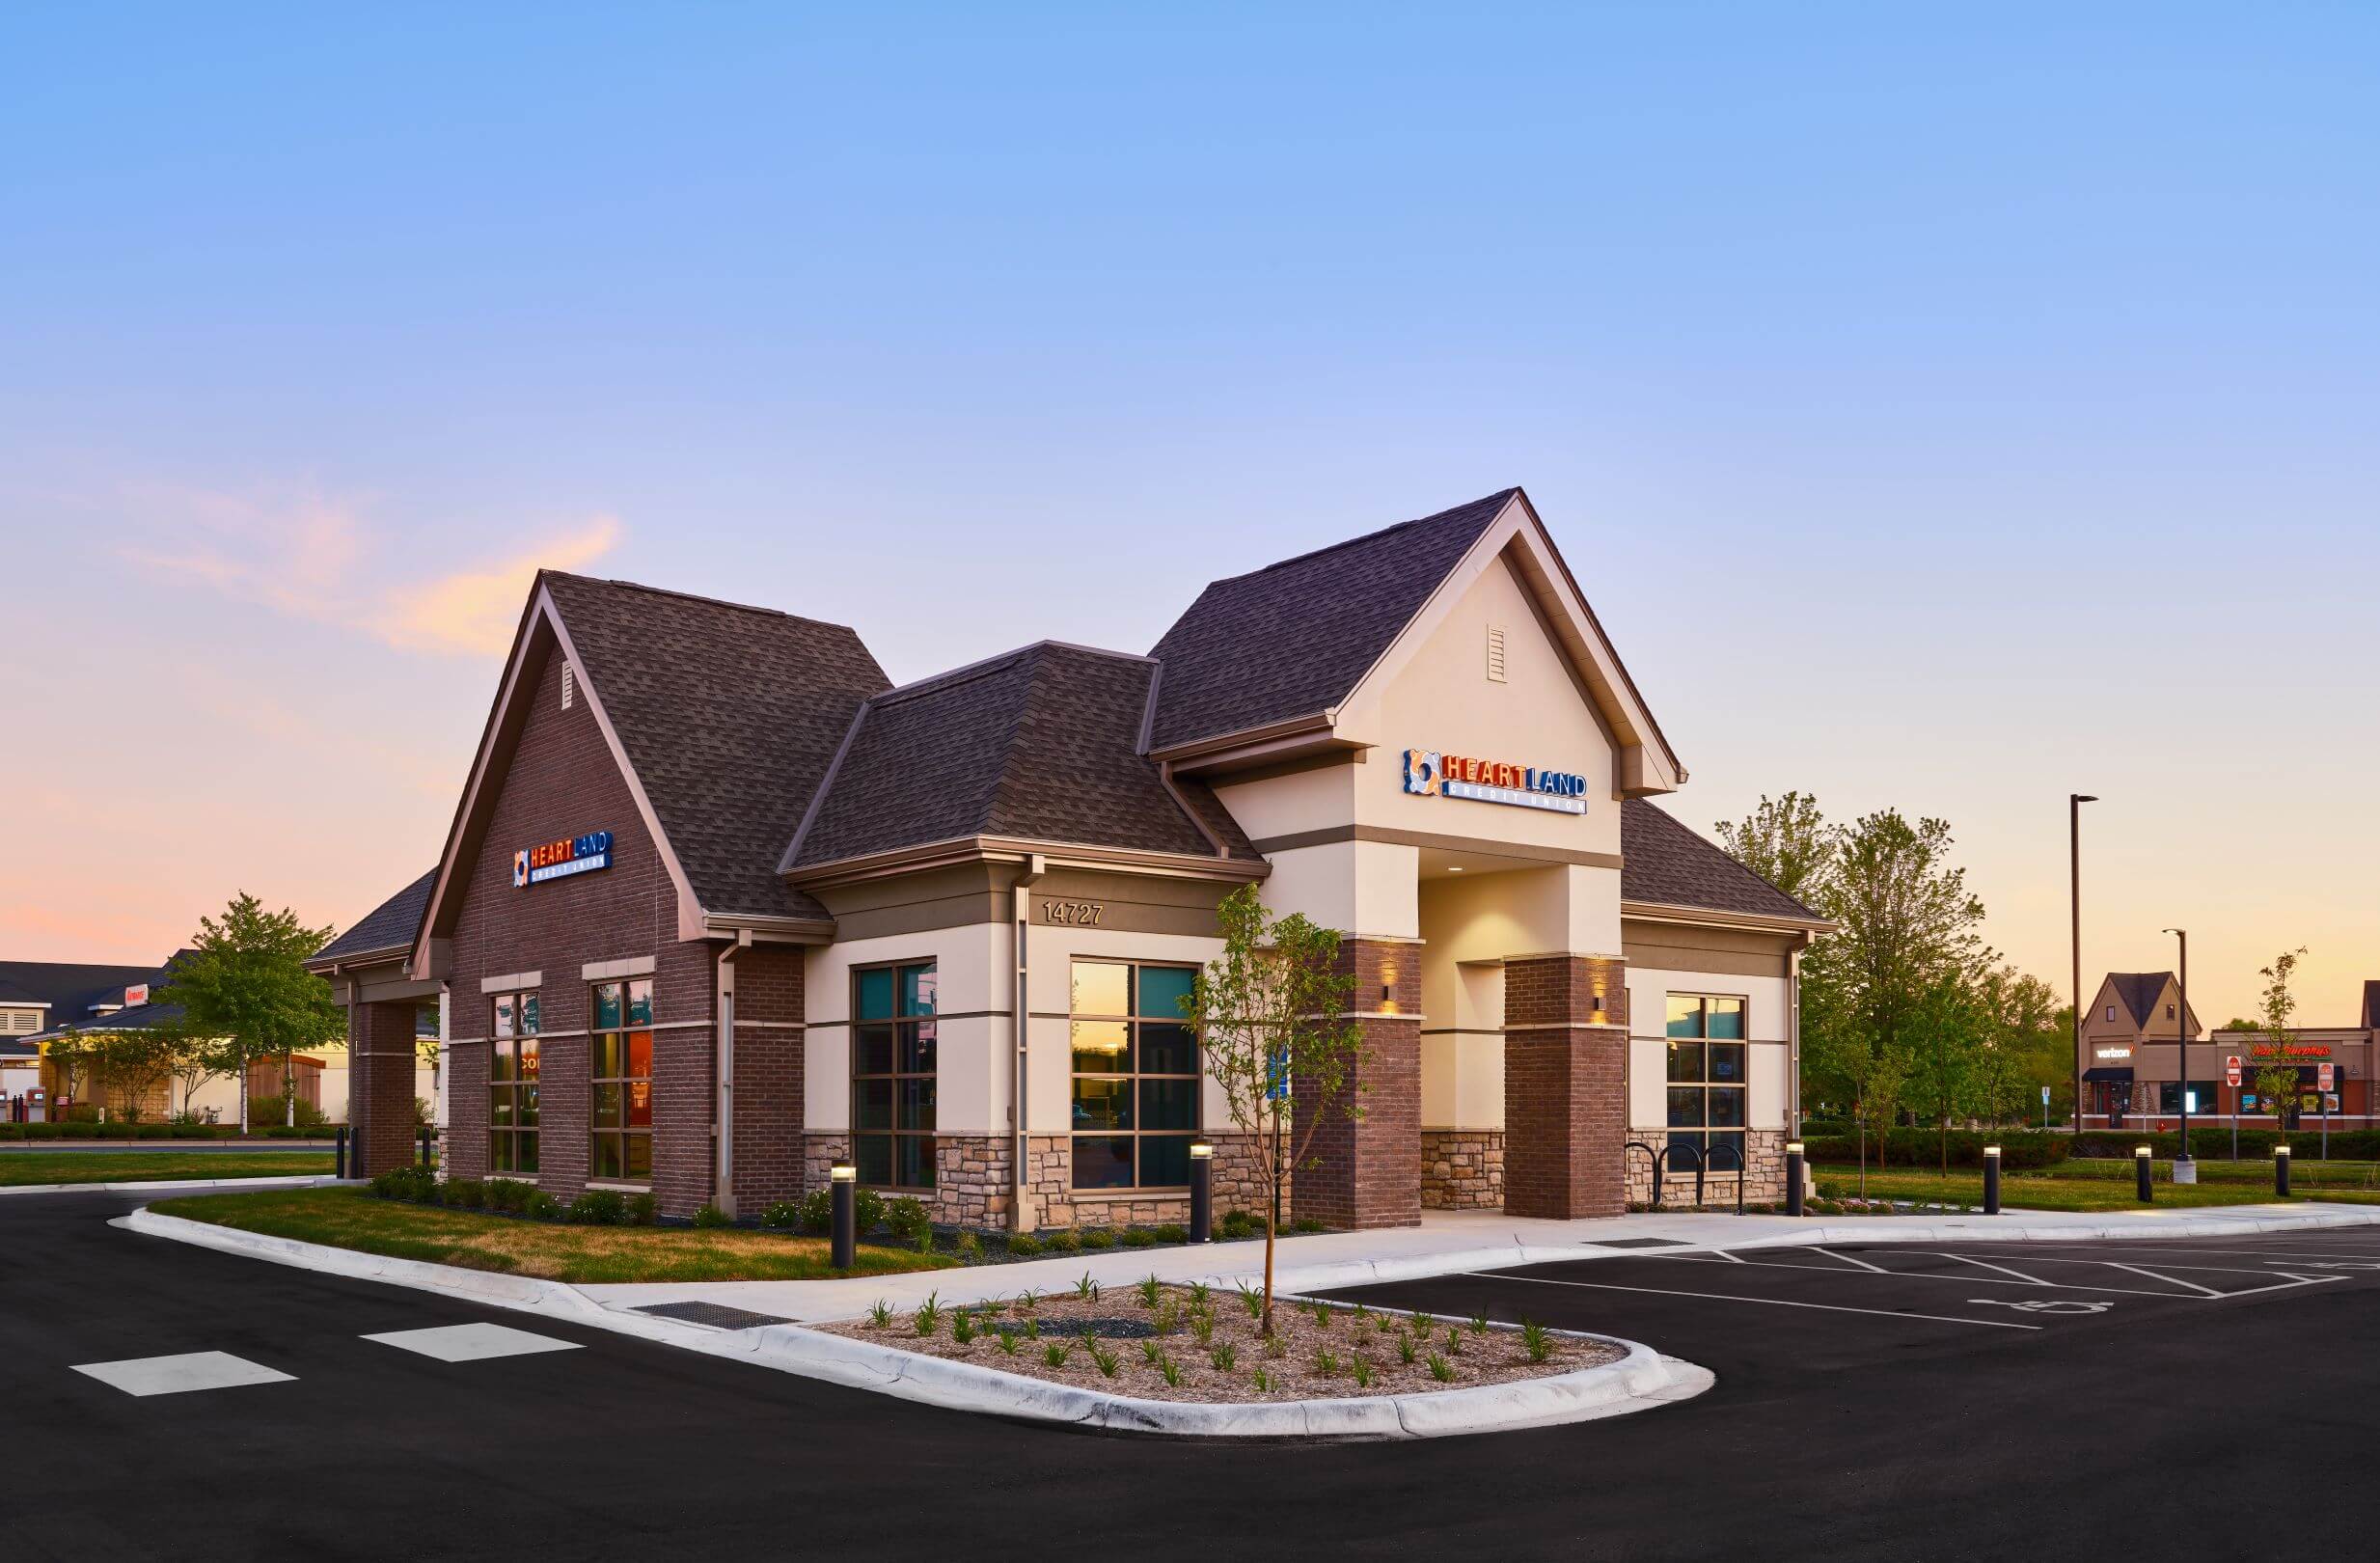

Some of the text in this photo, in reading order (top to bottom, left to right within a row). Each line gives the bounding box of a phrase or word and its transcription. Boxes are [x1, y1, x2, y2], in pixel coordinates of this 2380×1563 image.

[1442, 755, 1587, 797] HEARTLAND
[1450, 783, 1585, 812] CREDIT UNION
[531, 832, 612, 867] HEARTLAND
[1043, 901, 1104, 925] 14727
[2096, 1047, 2130, 1057] verizon
